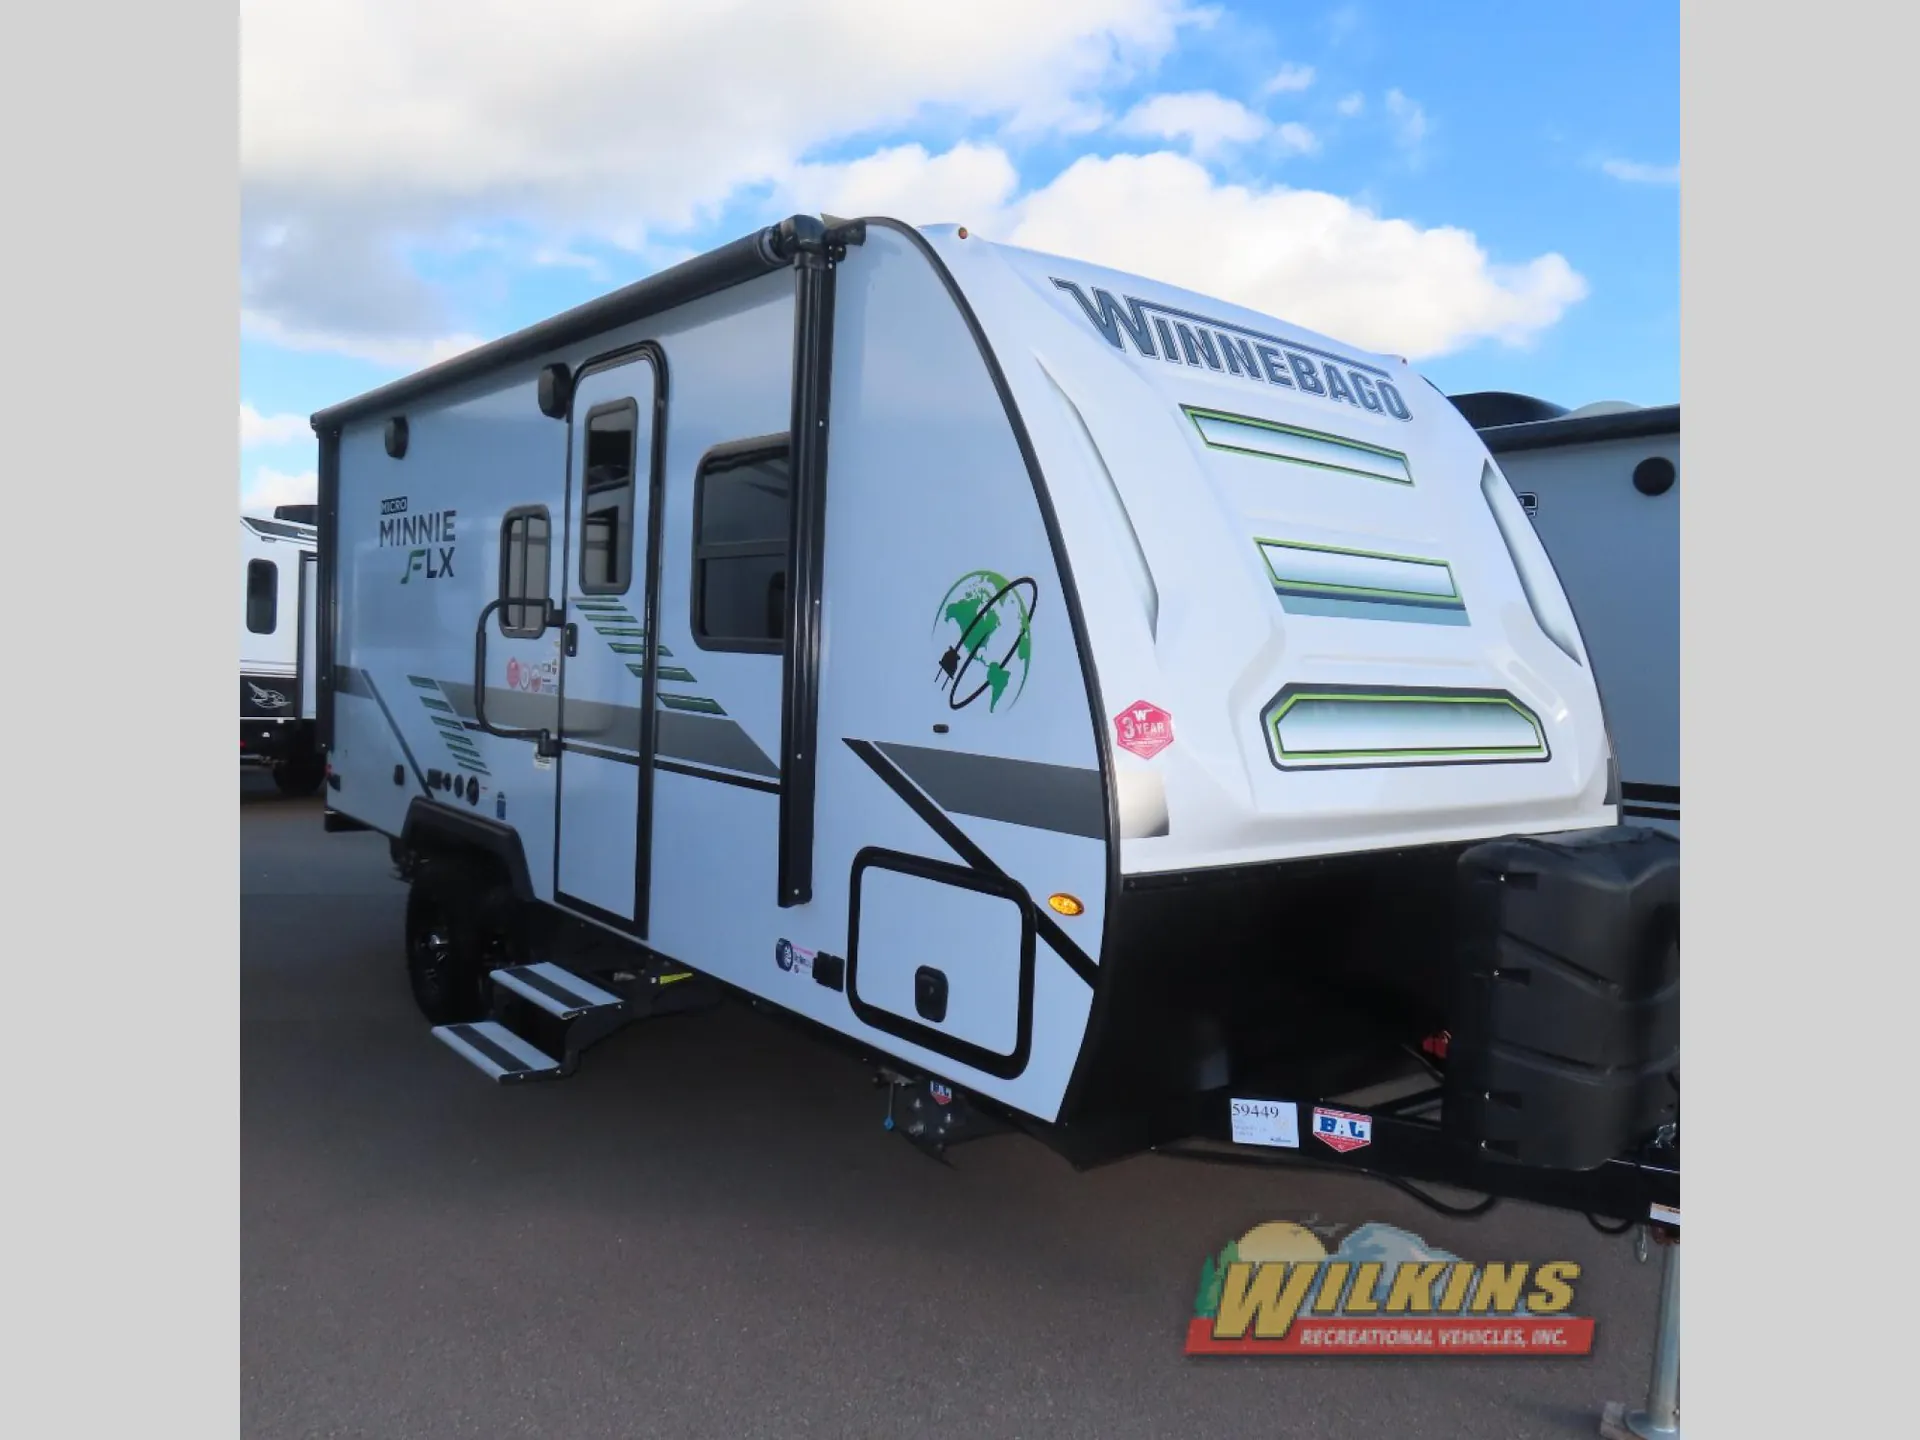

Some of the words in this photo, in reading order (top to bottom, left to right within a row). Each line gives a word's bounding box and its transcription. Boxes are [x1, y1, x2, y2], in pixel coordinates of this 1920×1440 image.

[1048, 276, 1413, 421] WINNEBAGO
[381, 496, 407, 515] MICRO
[380, 509, 456, 547] MINNIE
[400, 546, 455, 584] FLX
[1122, 716, 1135, 739] 3
[1135, 722, 1164, 736] YEAR
[1232, 1103, 1279, 1118] 59449
